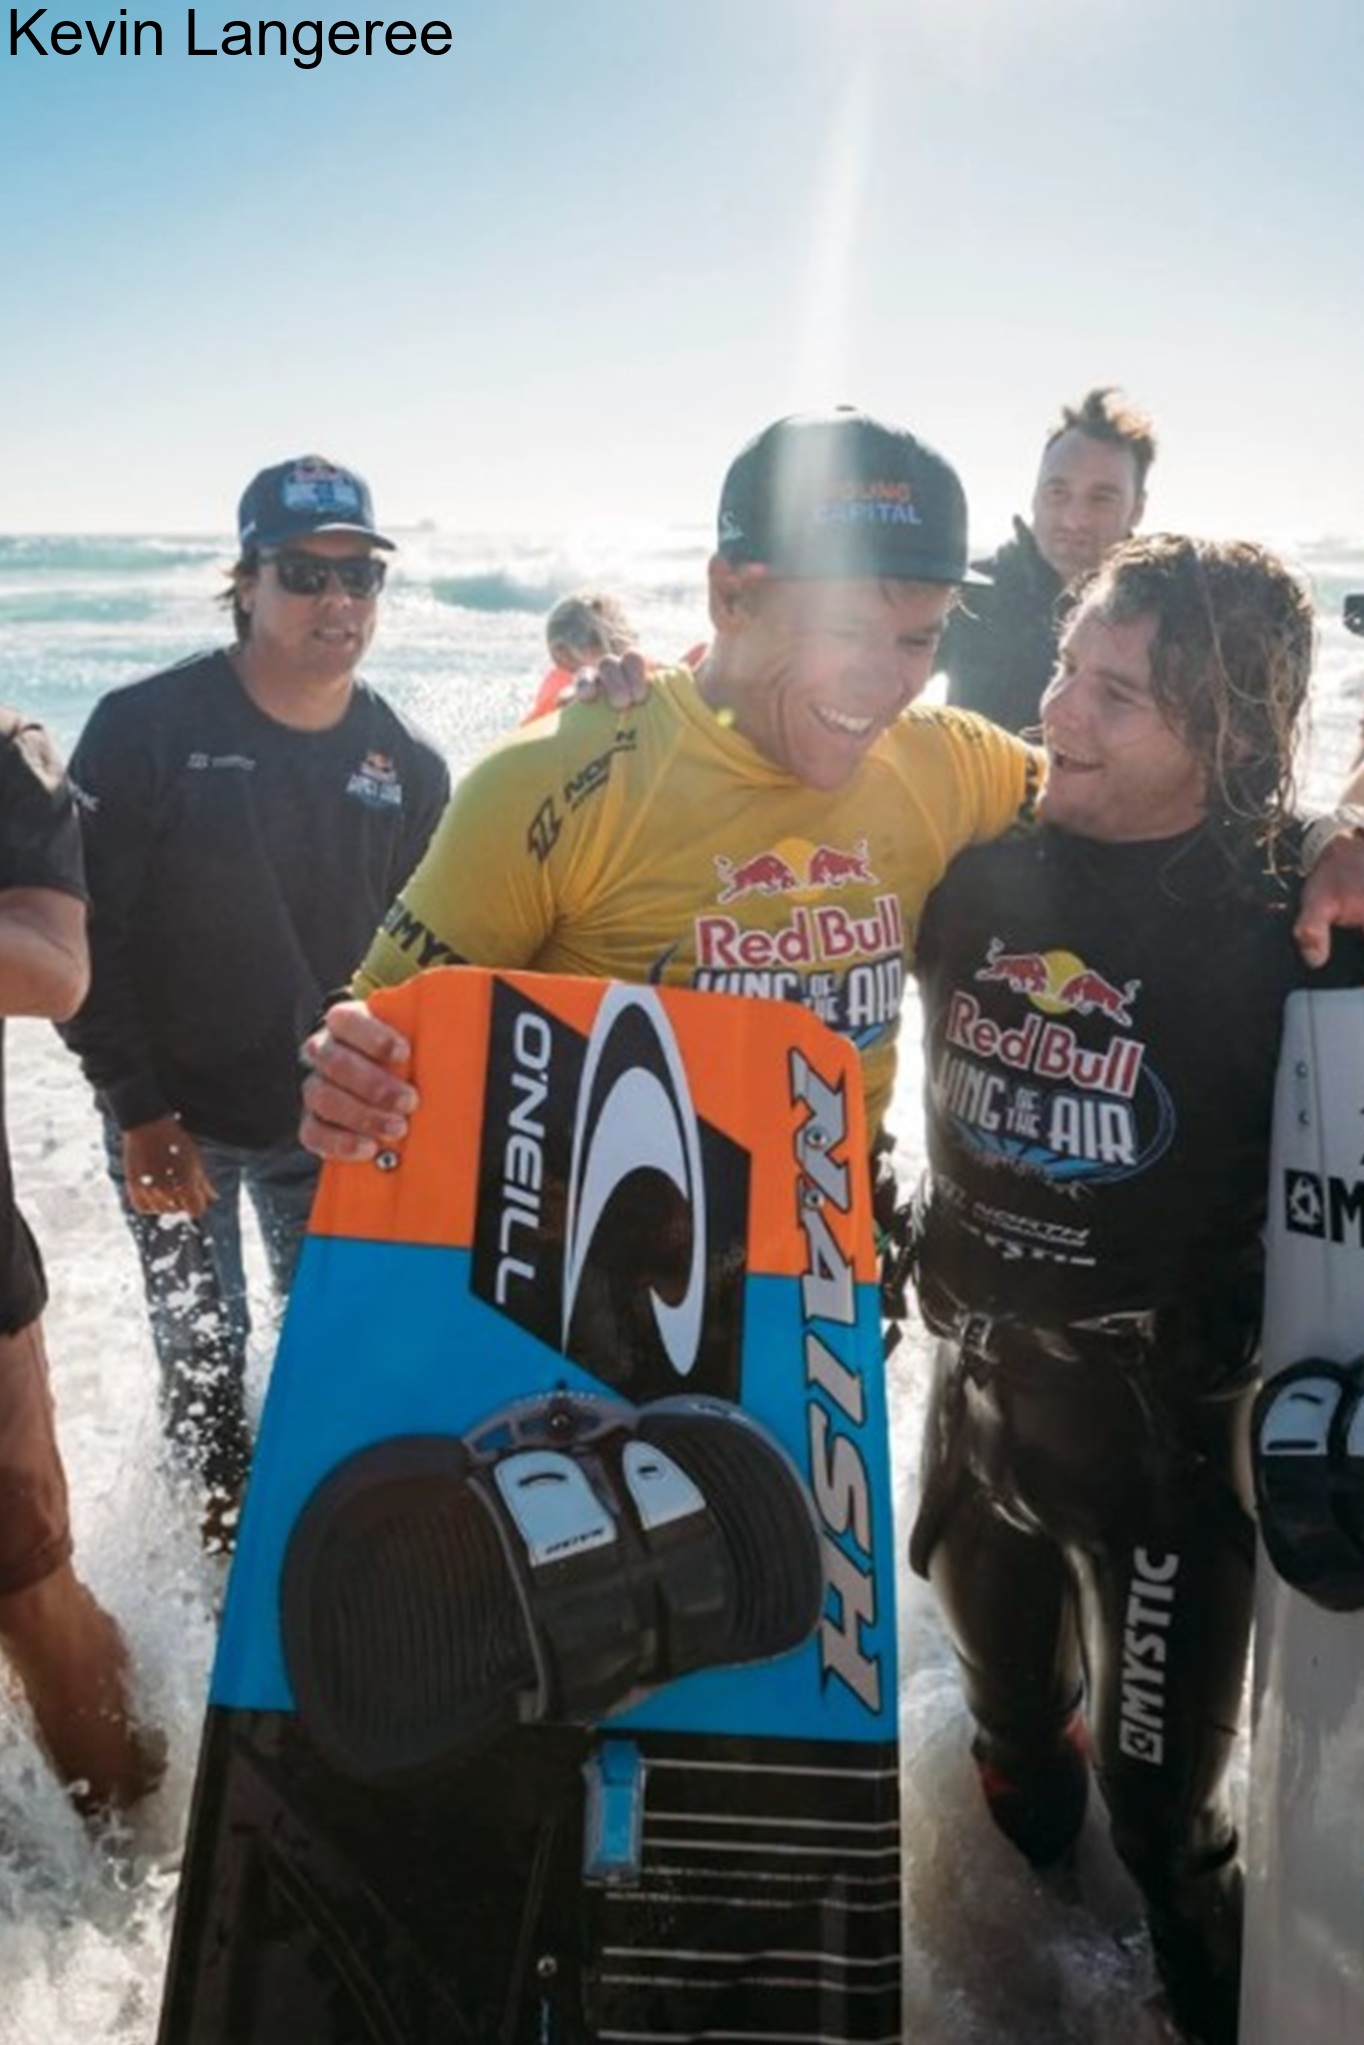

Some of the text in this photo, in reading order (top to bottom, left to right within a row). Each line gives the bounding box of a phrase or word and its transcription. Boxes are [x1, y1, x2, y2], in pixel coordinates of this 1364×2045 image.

[815, 503, 923, 525] CAPITAL
[695, 894, 903, 968] Red Bull
[946, 990, 1146, 1099] Red Bull
[495, 1011, 551, 1304] O'NEILL
[1006, 1108, 1042, 1139] THE
[1049, 1095, 1137, 1166] AIR
[788, 1046, 881, 1716] NAISH
[1121, 1546, 1180, 1731] MYSTIC
